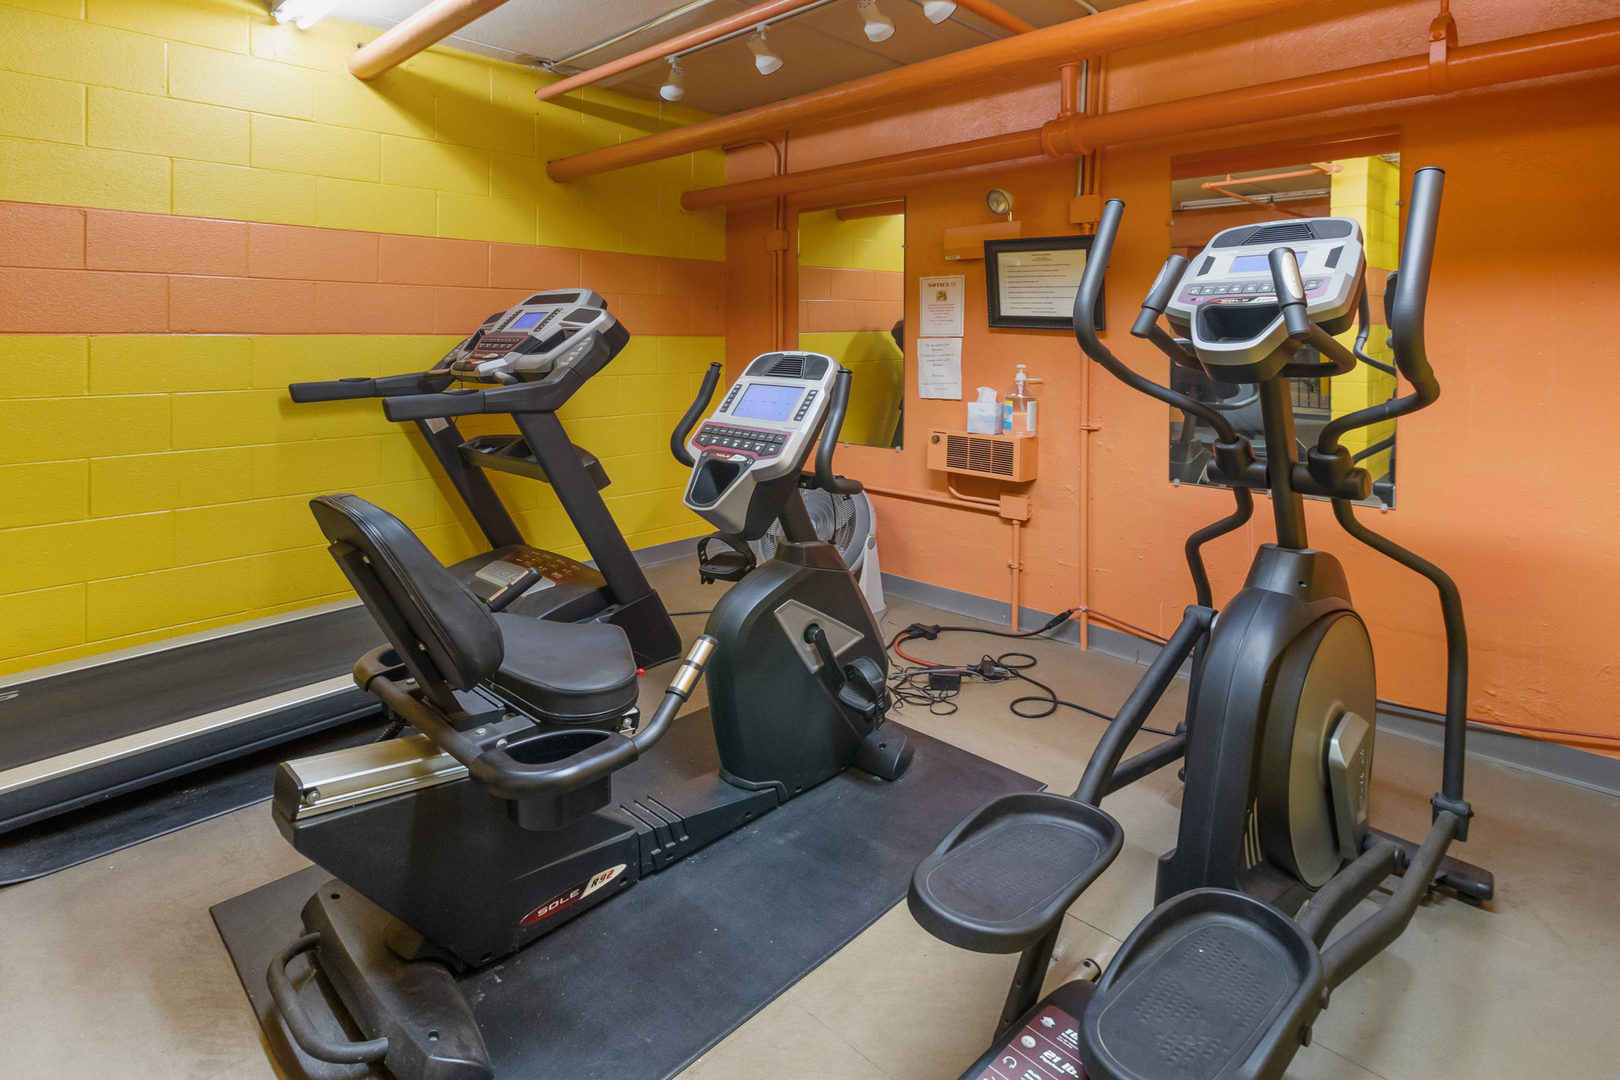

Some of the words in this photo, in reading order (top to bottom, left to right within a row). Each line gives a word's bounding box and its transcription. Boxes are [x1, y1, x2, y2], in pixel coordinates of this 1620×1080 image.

[537, 888, 580, 917] SOLE
[590, 869, 615, 889] R92
[1042, 1049, 1062, 1063] 21
[1061, 1062, 1079, 1079] lb.
